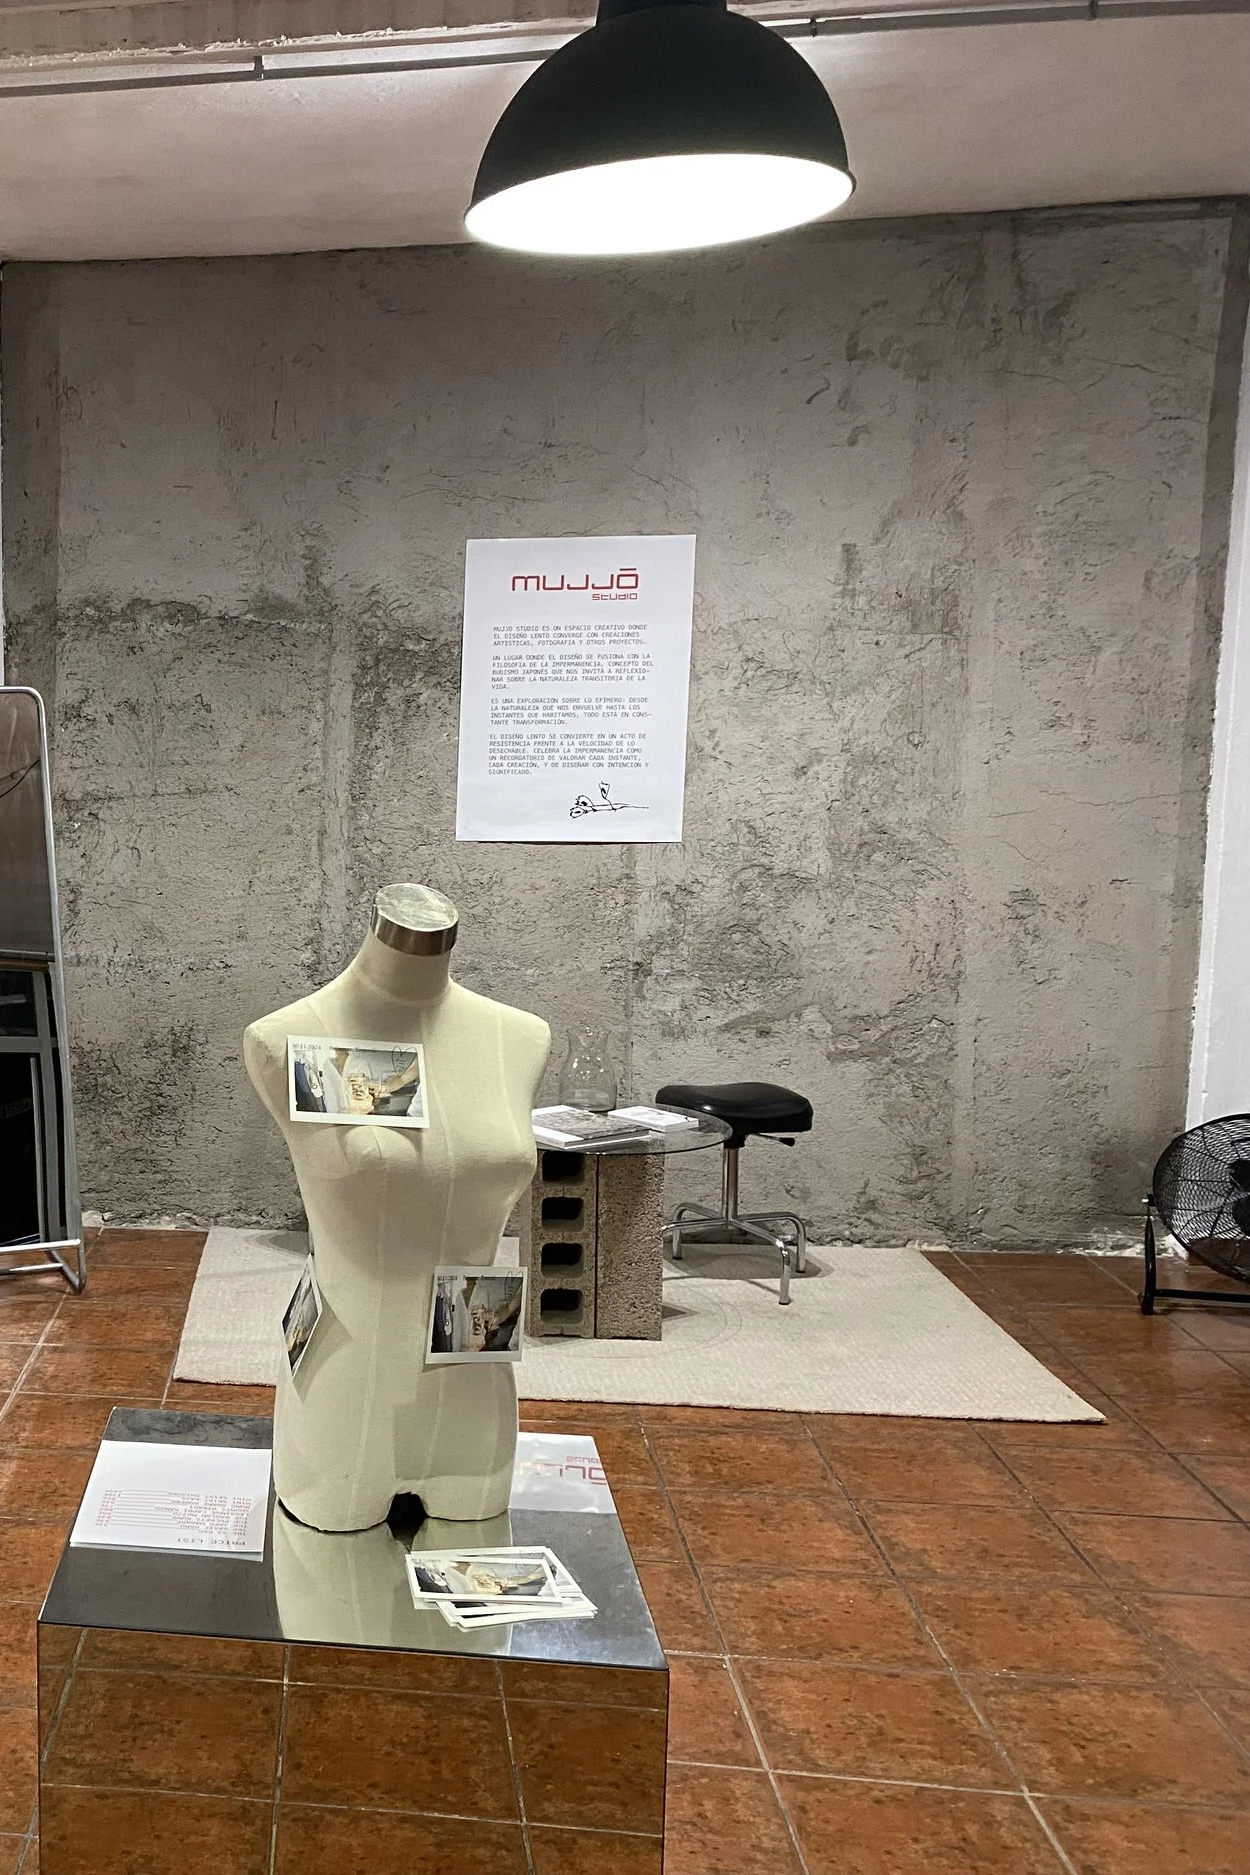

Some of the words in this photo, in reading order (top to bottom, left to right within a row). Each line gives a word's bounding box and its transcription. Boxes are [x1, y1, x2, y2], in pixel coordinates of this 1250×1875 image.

[559, 653, 582, 661] DISEÑO
[552, 661, 604, 669] IMPERMANENCIA,
[562, 761, 589, 769] DISEÑAR
